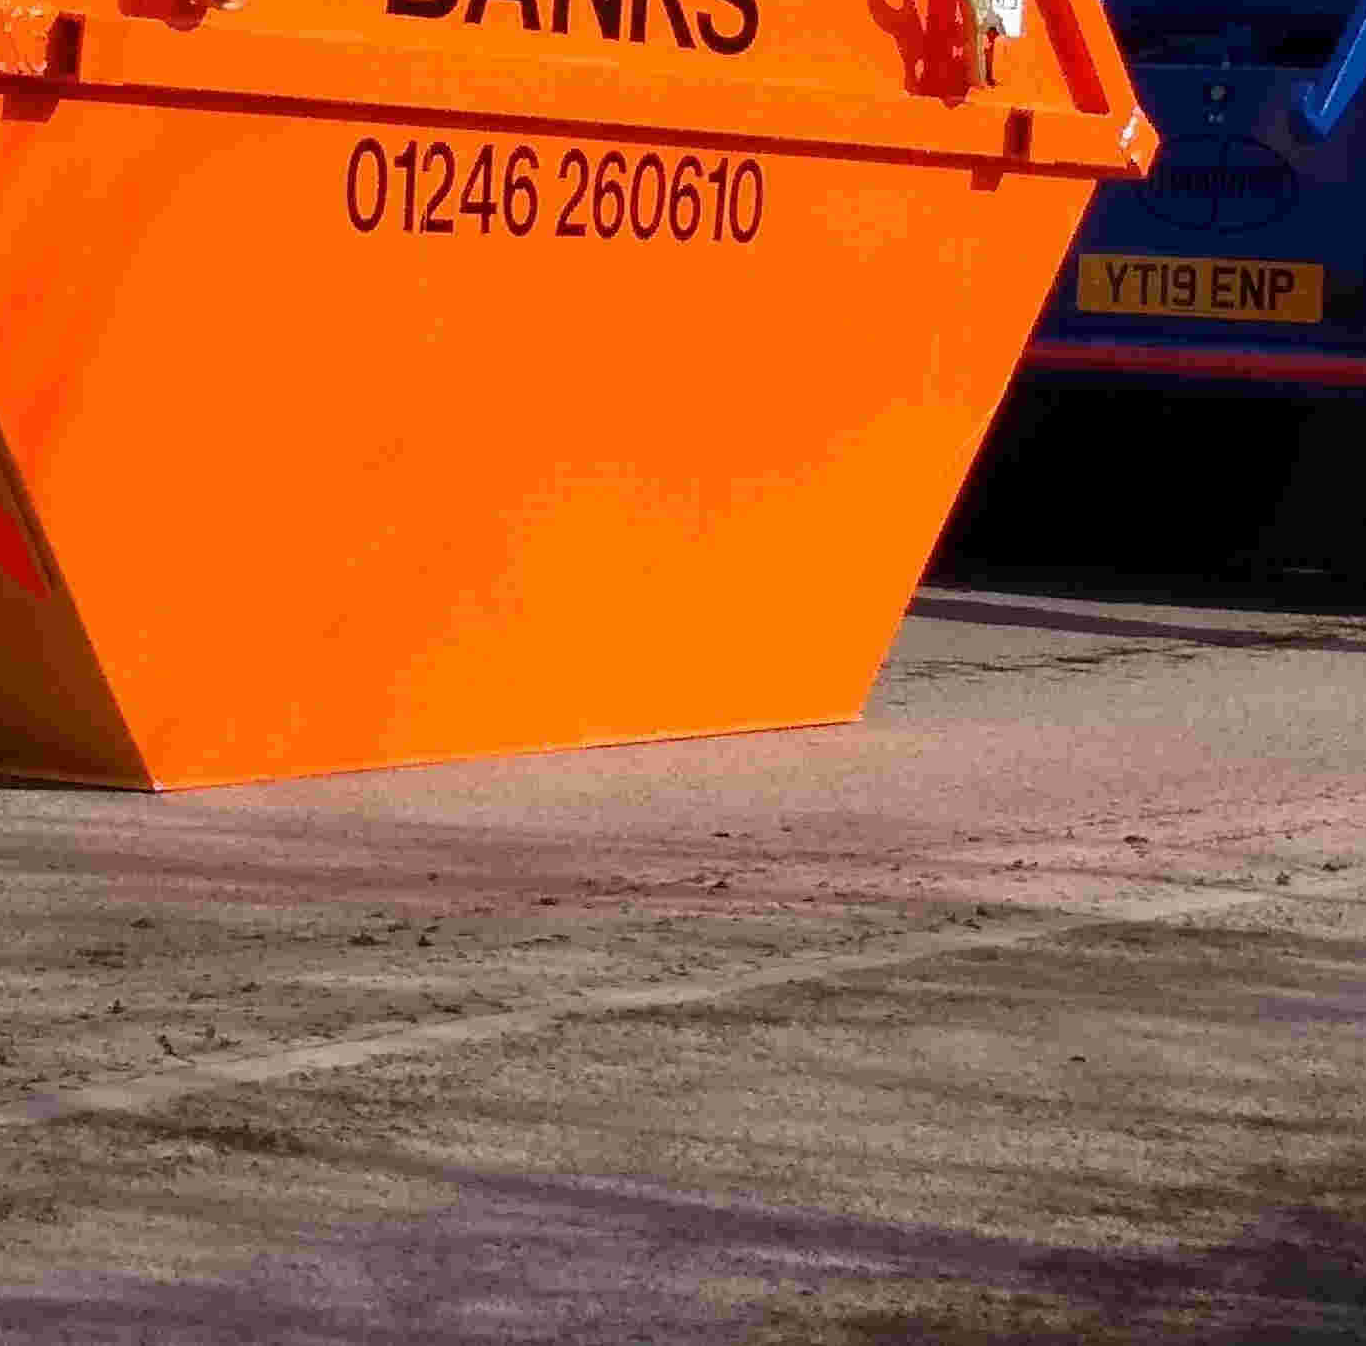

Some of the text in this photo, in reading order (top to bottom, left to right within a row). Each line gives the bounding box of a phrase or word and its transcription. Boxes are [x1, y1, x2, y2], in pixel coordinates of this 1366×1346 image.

[346, 137, 764, 244] 01246 260610
[1105, 261, 1296, 312] YT19 ENP
